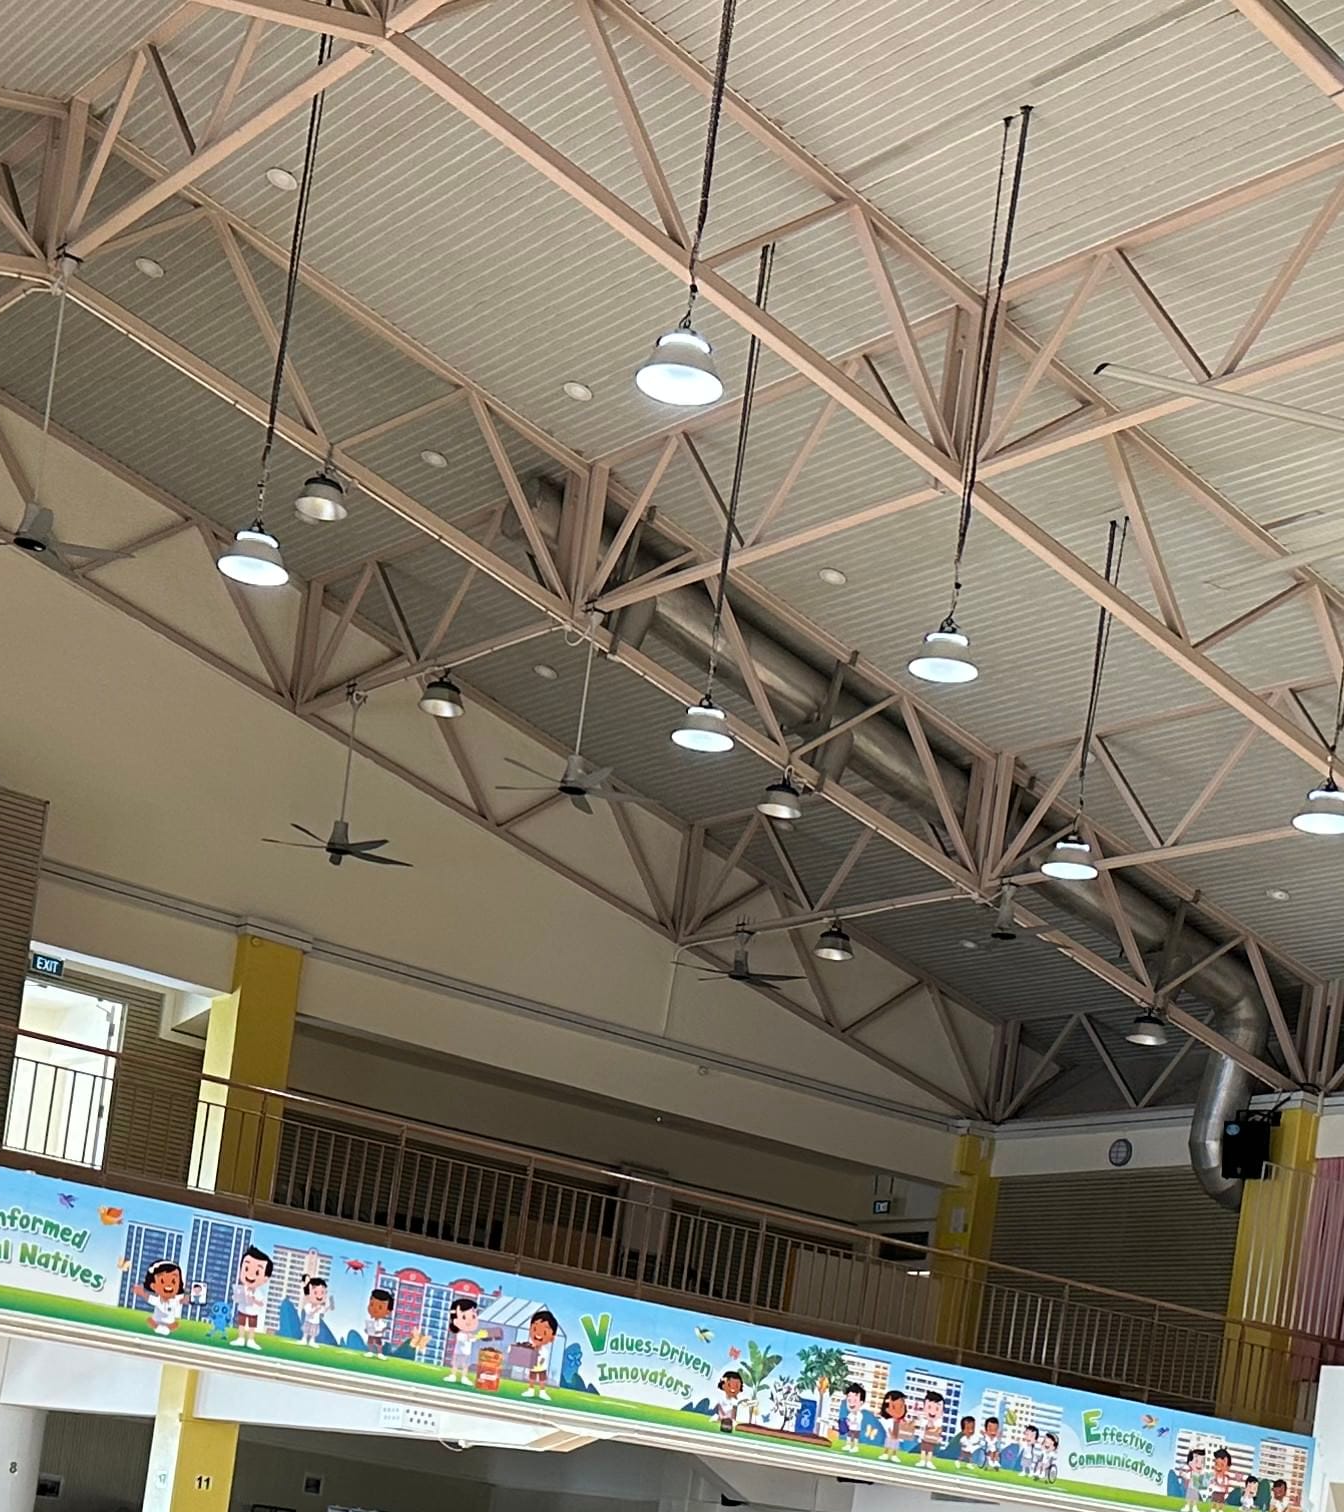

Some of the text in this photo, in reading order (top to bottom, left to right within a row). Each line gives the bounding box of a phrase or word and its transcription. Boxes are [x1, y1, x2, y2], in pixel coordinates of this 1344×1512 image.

[36, 956, 58, 973] EXIT
[19, 1242, 104, 1288] Natives
[580, 1313, 712, 1377] Values-Driven
[596, 1363, 691, 1397] Innovators
[1083, 1409, 1153, 1454] Effective
[9, 1462, 17, 1473] 8
[197, 1475, 210, 1490] 11
[1068, 1452, 1163, 1482] Communicators
